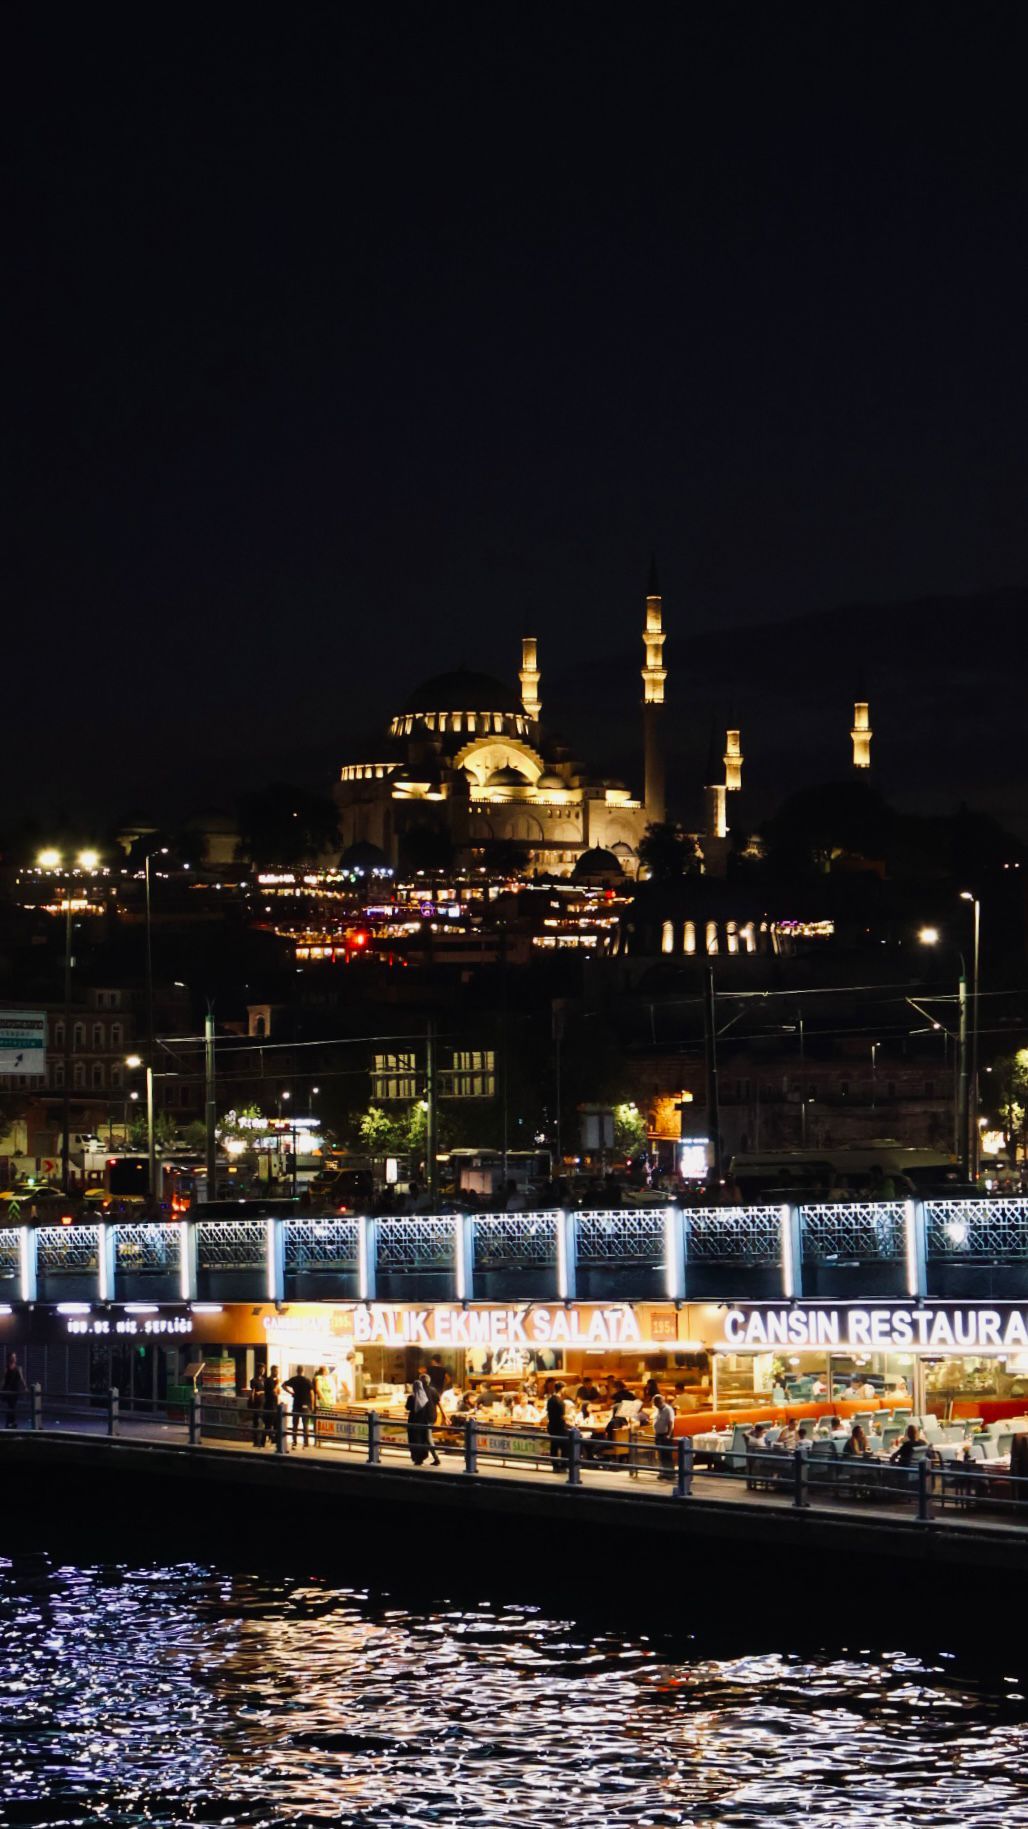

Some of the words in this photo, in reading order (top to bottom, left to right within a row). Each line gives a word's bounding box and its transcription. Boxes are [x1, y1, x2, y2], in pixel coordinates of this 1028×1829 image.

[353, 1311, 430, 1341] BALIK
[434, 1311, 527, 1342] EKMEK
[532, 1309, 641, 1342] SALATA
[724, 1310, 839, 1345] CANSIN
[847, 1310, 1028, 1345] RESTAURA
